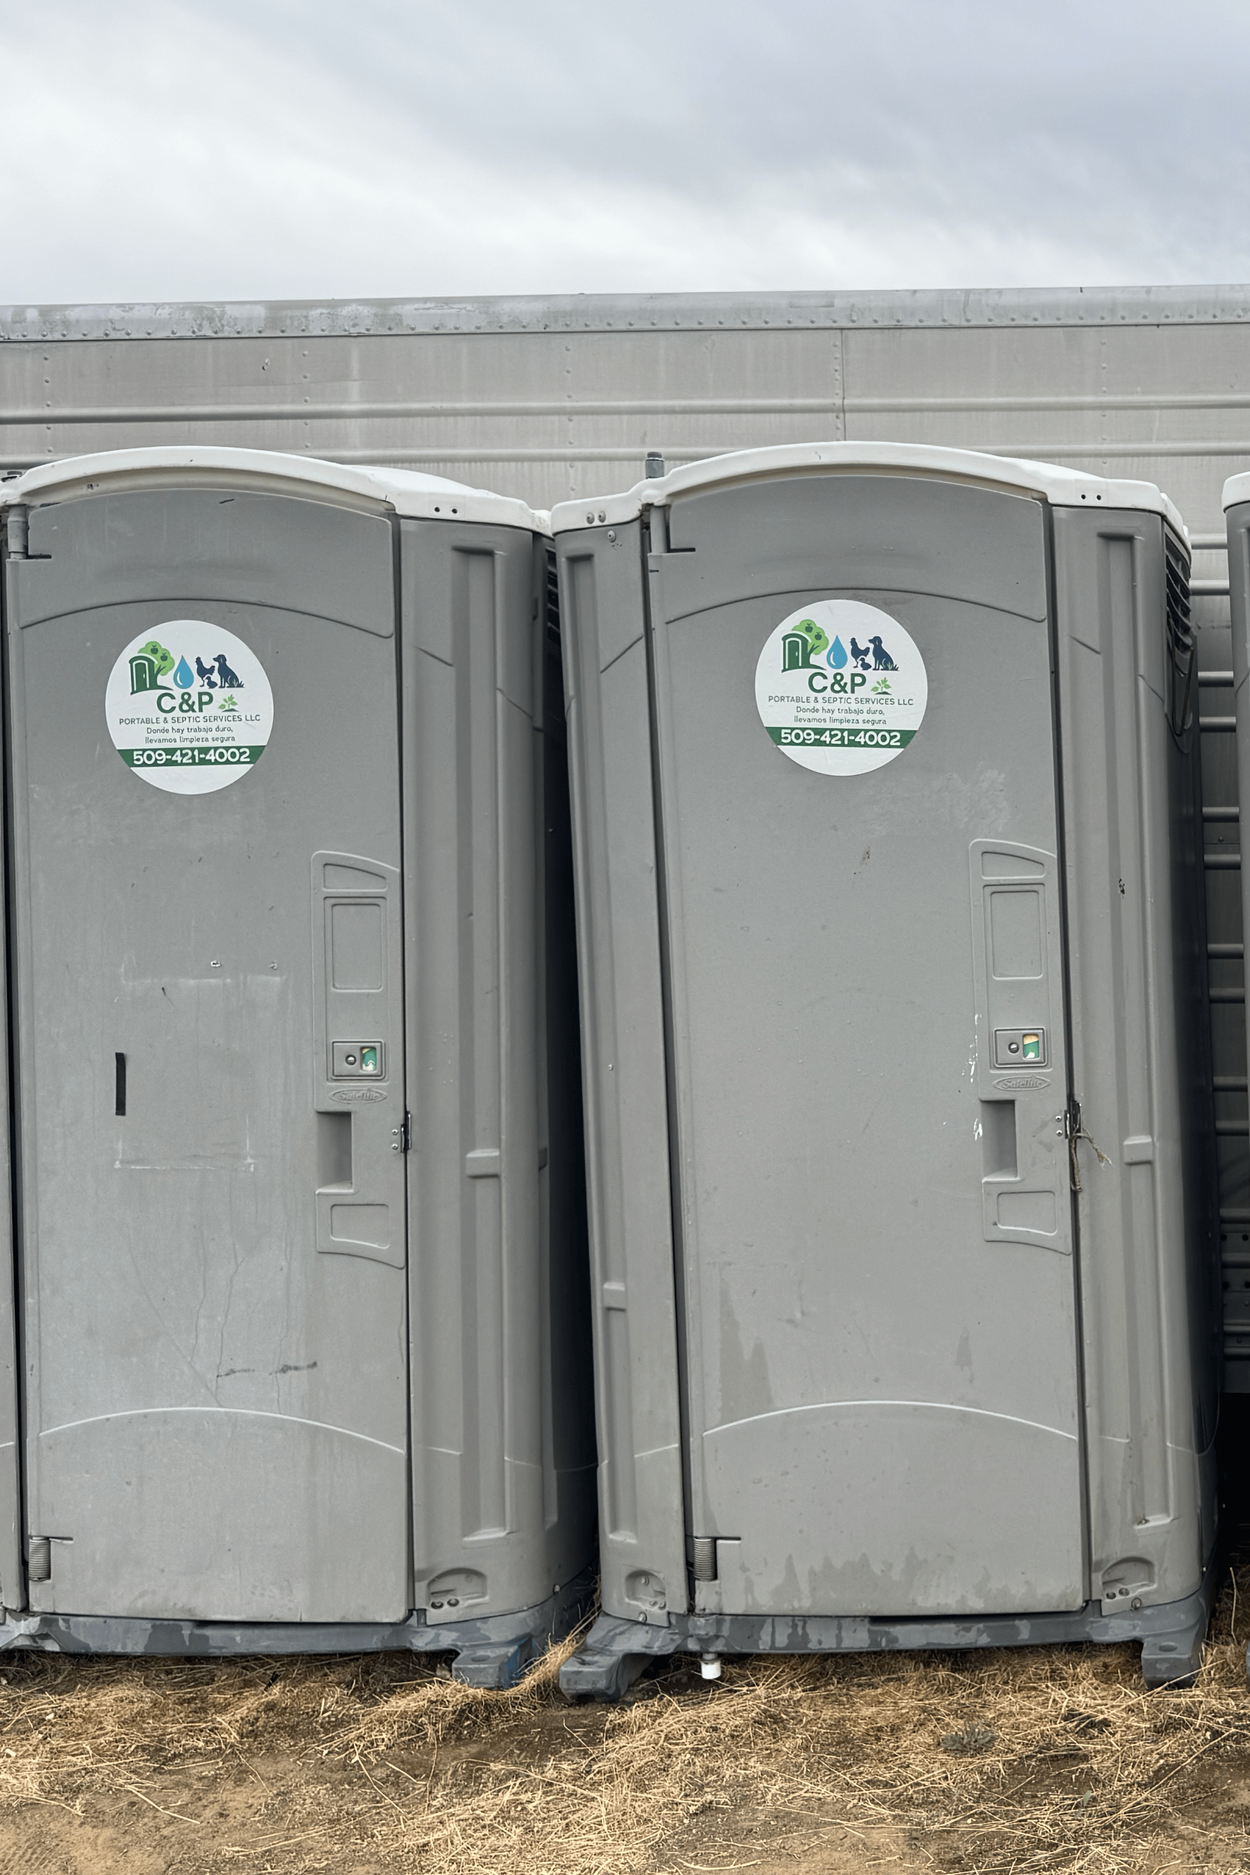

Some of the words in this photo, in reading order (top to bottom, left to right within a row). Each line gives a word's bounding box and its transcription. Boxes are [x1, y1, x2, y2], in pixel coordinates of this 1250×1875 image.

[808, 672, 867, 694] C&P
[156, 691, 213, 713] C&P
[855, 697, 895, 705] SERVICES
[796, 706, 820, 714] Donde
[838, 707, 864, 715] trabajo
[829, 716, 860, 725] limpieza
[171, 726, 184, 734] hay
[215, 725, 233, 733] duro,
[145, 735, 177, 744] llevamos
[180, 735, 209, 743] limpieza
[212, 735, 235, 743] segura
[781, 729, 900, 746] 509-421-4002
[133, 748, 250, 764] 509-421-4002
